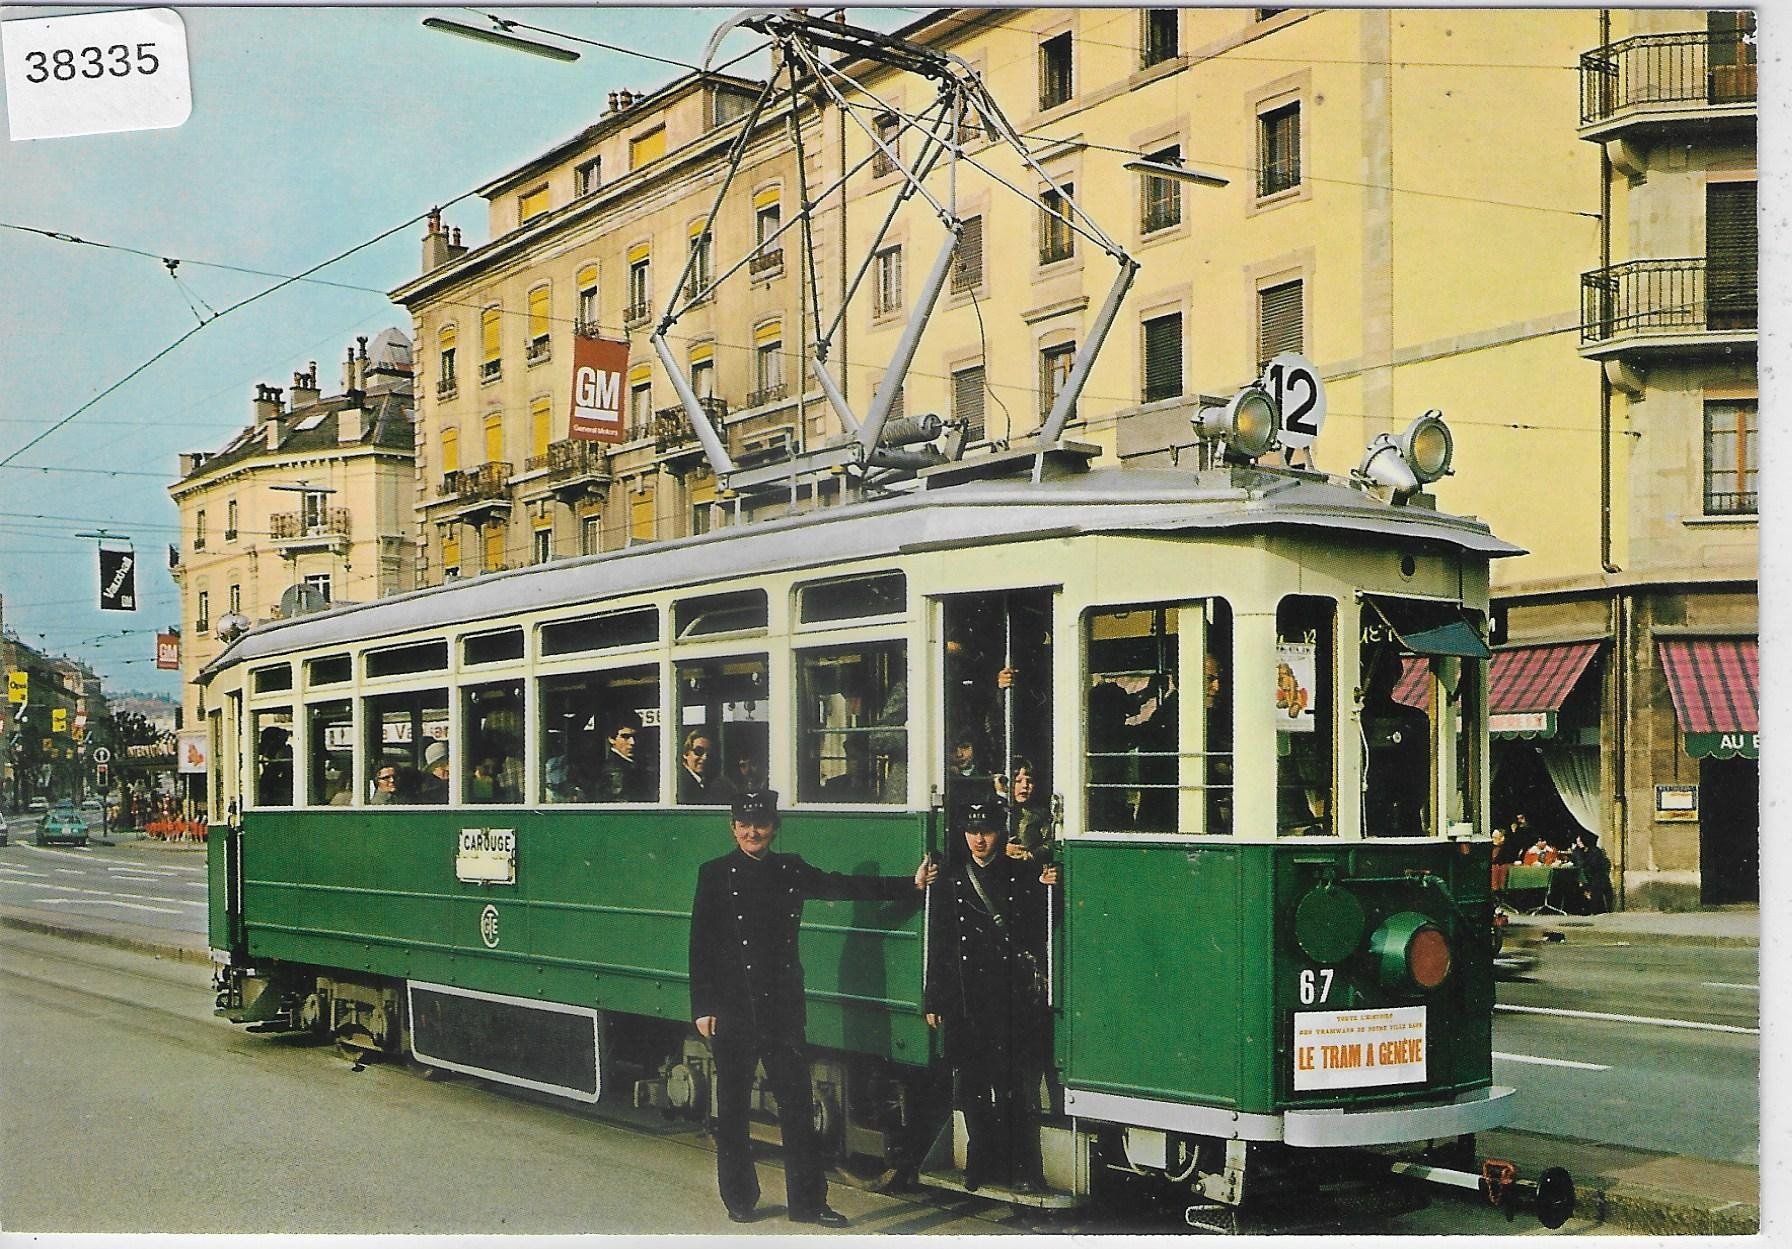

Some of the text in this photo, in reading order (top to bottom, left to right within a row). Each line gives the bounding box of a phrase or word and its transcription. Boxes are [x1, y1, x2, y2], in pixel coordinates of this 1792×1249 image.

[25, 42, 159, 84] 38335
[575, 366, 621, 411] GM
[1269, 363, 1318, 437] 12
[102, 555, 133, 599] Vauxhall
[1720, 734, 1744, 749] AU
[463, 834, 511, 853] CAROUGE
[1299, 968, 1334, 1005] 67
[1298, 1038, 1423, 1070] LE TRAM A GENÈVE
